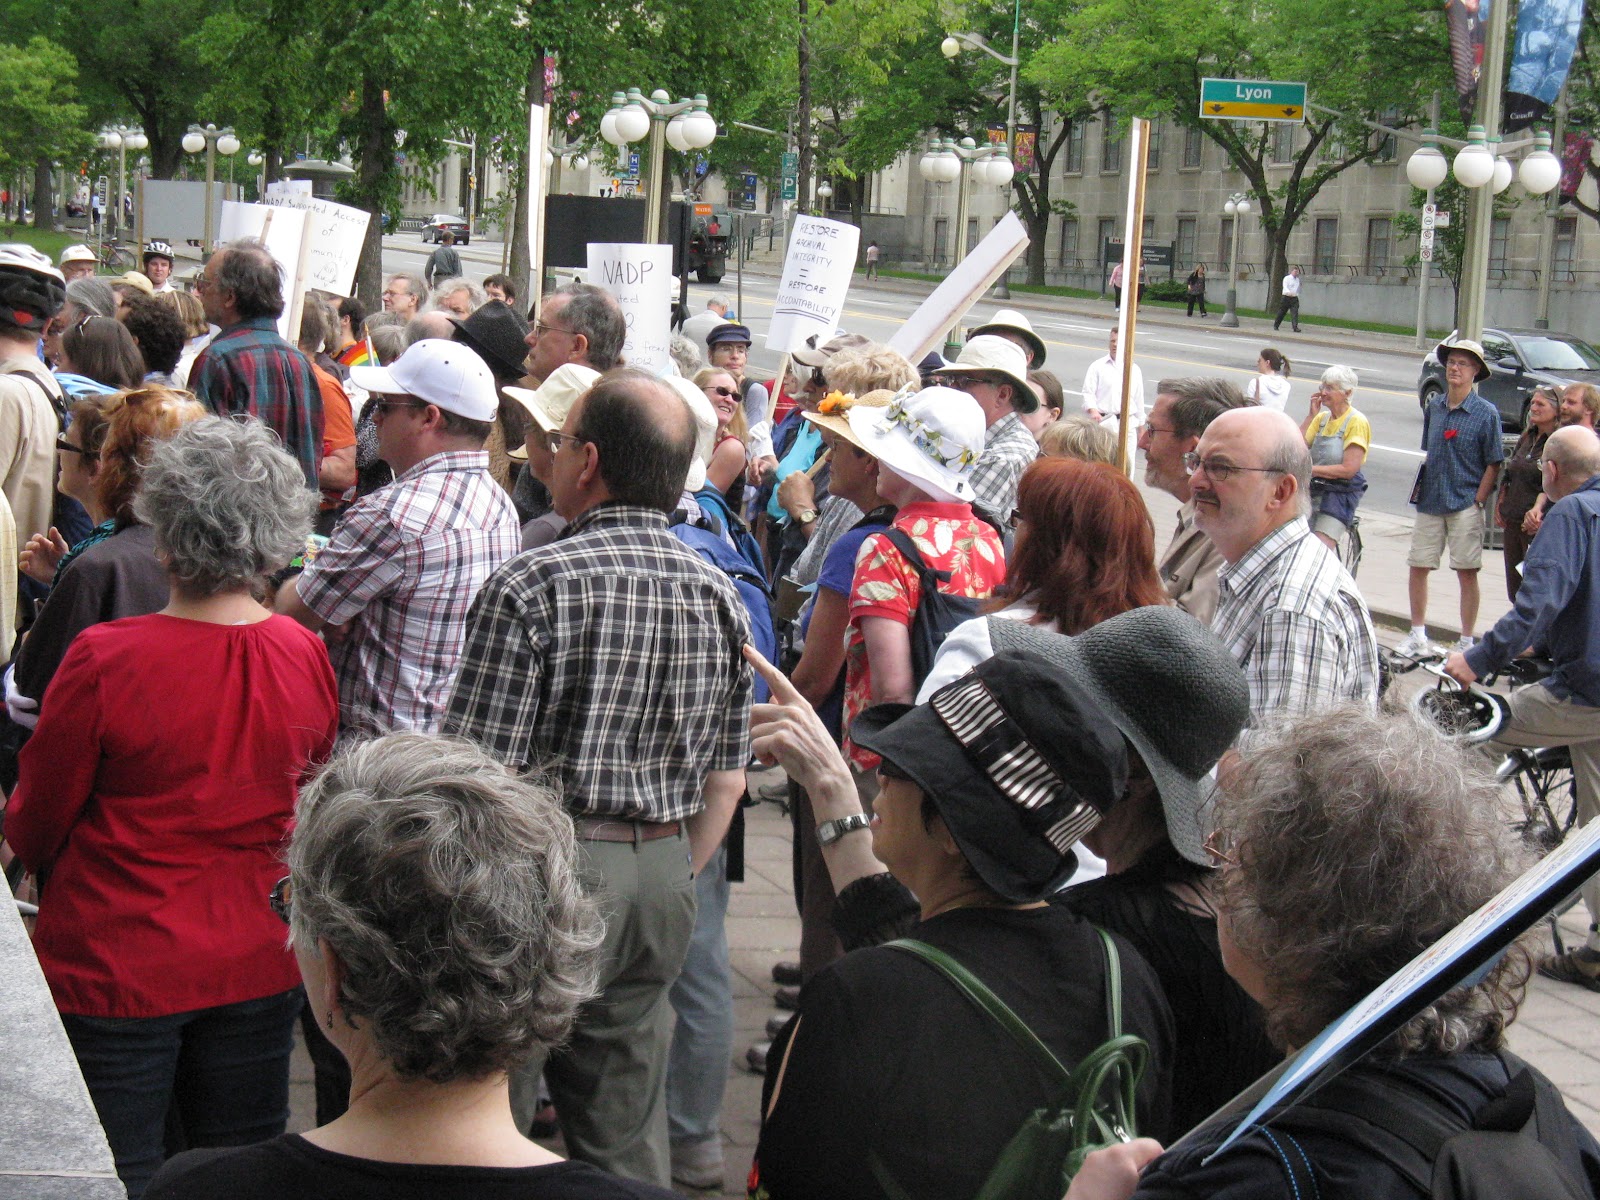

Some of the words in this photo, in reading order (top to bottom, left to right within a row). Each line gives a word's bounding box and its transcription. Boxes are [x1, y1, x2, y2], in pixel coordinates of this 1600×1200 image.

[1236, 84, 1272, 100] Lyon
[784, 177, 794, 191] P
[333, 208, 367, 226] Access
[321, 223, 338, 236] of
[799, 223, 839, 239] RESTORE
[792, 251, 833, 268] INTEGRITY
[602, 259, 653, 285] NADP
[788, 280, 827, 294] RESTORE
[629, 357, 654, 367] 2012
